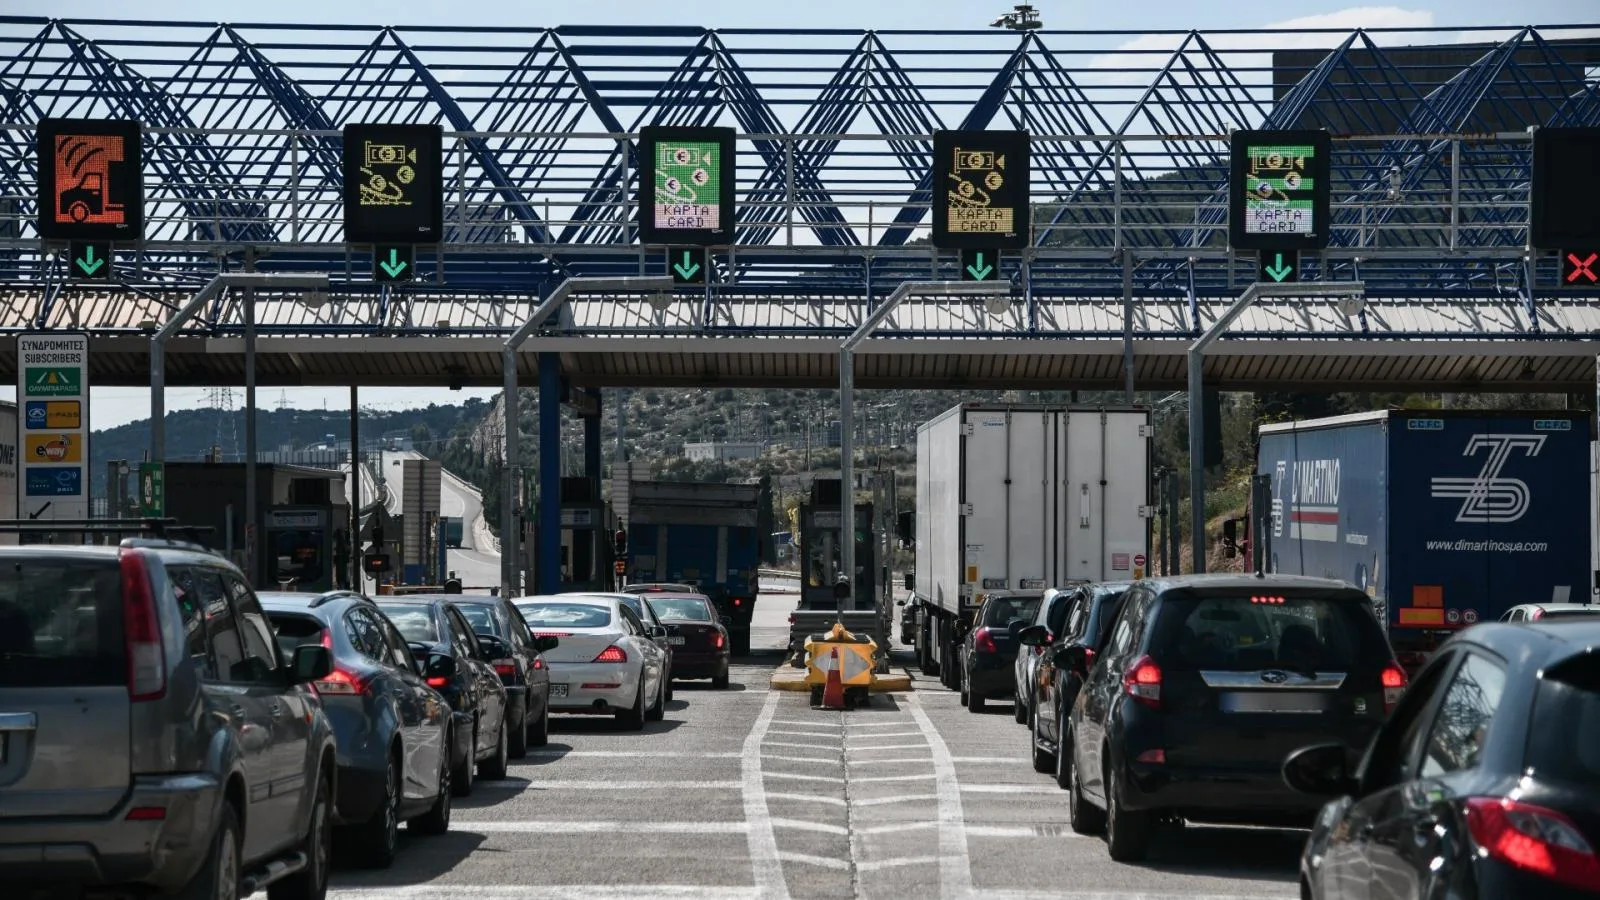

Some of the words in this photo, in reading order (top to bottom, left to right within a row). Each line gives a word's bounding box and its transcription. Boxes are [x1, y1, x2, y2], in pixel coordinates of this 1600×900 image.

[664, 205, 709, 215] ΚΑΡΤΑ
[957, 209, 1003, 219] ΚΑΡΤΑ
[1255, 209, 1302, 220] ΚΑΡΤΑ
[668, 217, 703, 227] CARD
[961, 221, 997, 231] CARD
[1260, 221, 1296, 232] CARD
[21, 340, 84, 350] ΣΥΝΔΡΟΜΗΤΕΣ
[25, 353, 81, 363] SUBSCRIBERS
[1301, 458, 1340, 505] MARTINO
[1426, 539, 1548, 554] www.dimartinospa.com
